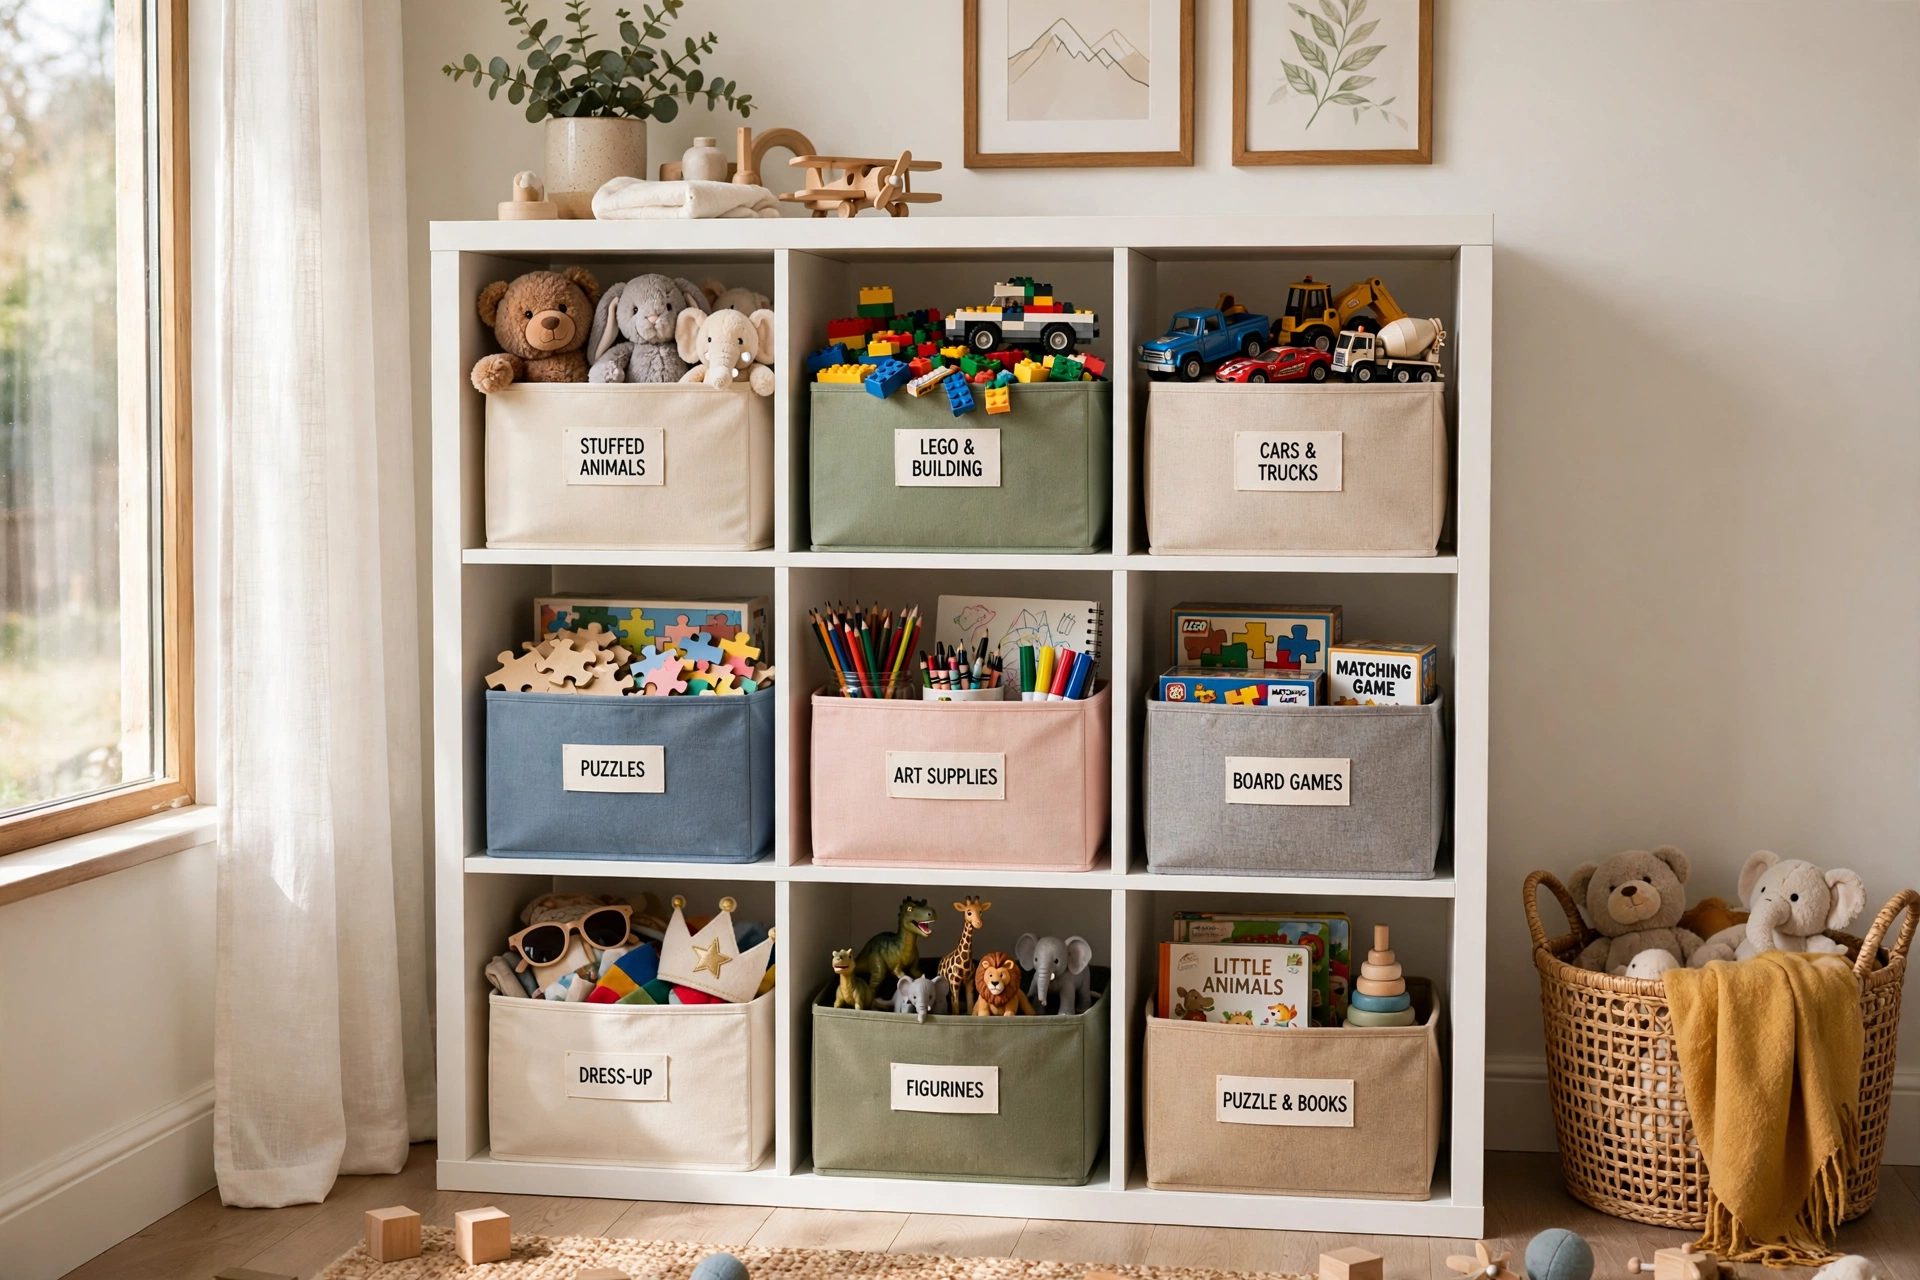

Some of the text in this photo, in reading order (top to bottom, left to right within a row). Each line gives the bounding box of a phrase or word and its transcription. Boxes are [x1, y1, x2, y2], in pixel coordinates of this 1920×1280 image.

[580, 437, 645, 455] STUFFED
[920, 437, 975, 456] LEGO &
[1260, 441, 1317, 460] CARS &
[579, 458, 646, 477] ANIMALS
[912, 459, 983, 478] BUILDING
[1257, 463, 1319, 482] TRUCKS
[1336, 659, 1412, 680] MATCHING
[1352, 678, 1396, 697] GAME
[581, 759, 645, 778] PUZZLES
[893, 766, 998, 786] ART SUPPLIES
[1233, 772, 1343, 791] BOARD GAMES
[1213, 956, 1272, 976] LITTLE
[1202, 976, 1284, 996] ANIMALS
[579, 1066, 653, 1086] DRESS-UP
[906, 1079, 984, 1099] FIGURINES
[1223, 1091, 1348, 1113] PUZZLE & BOOKS
